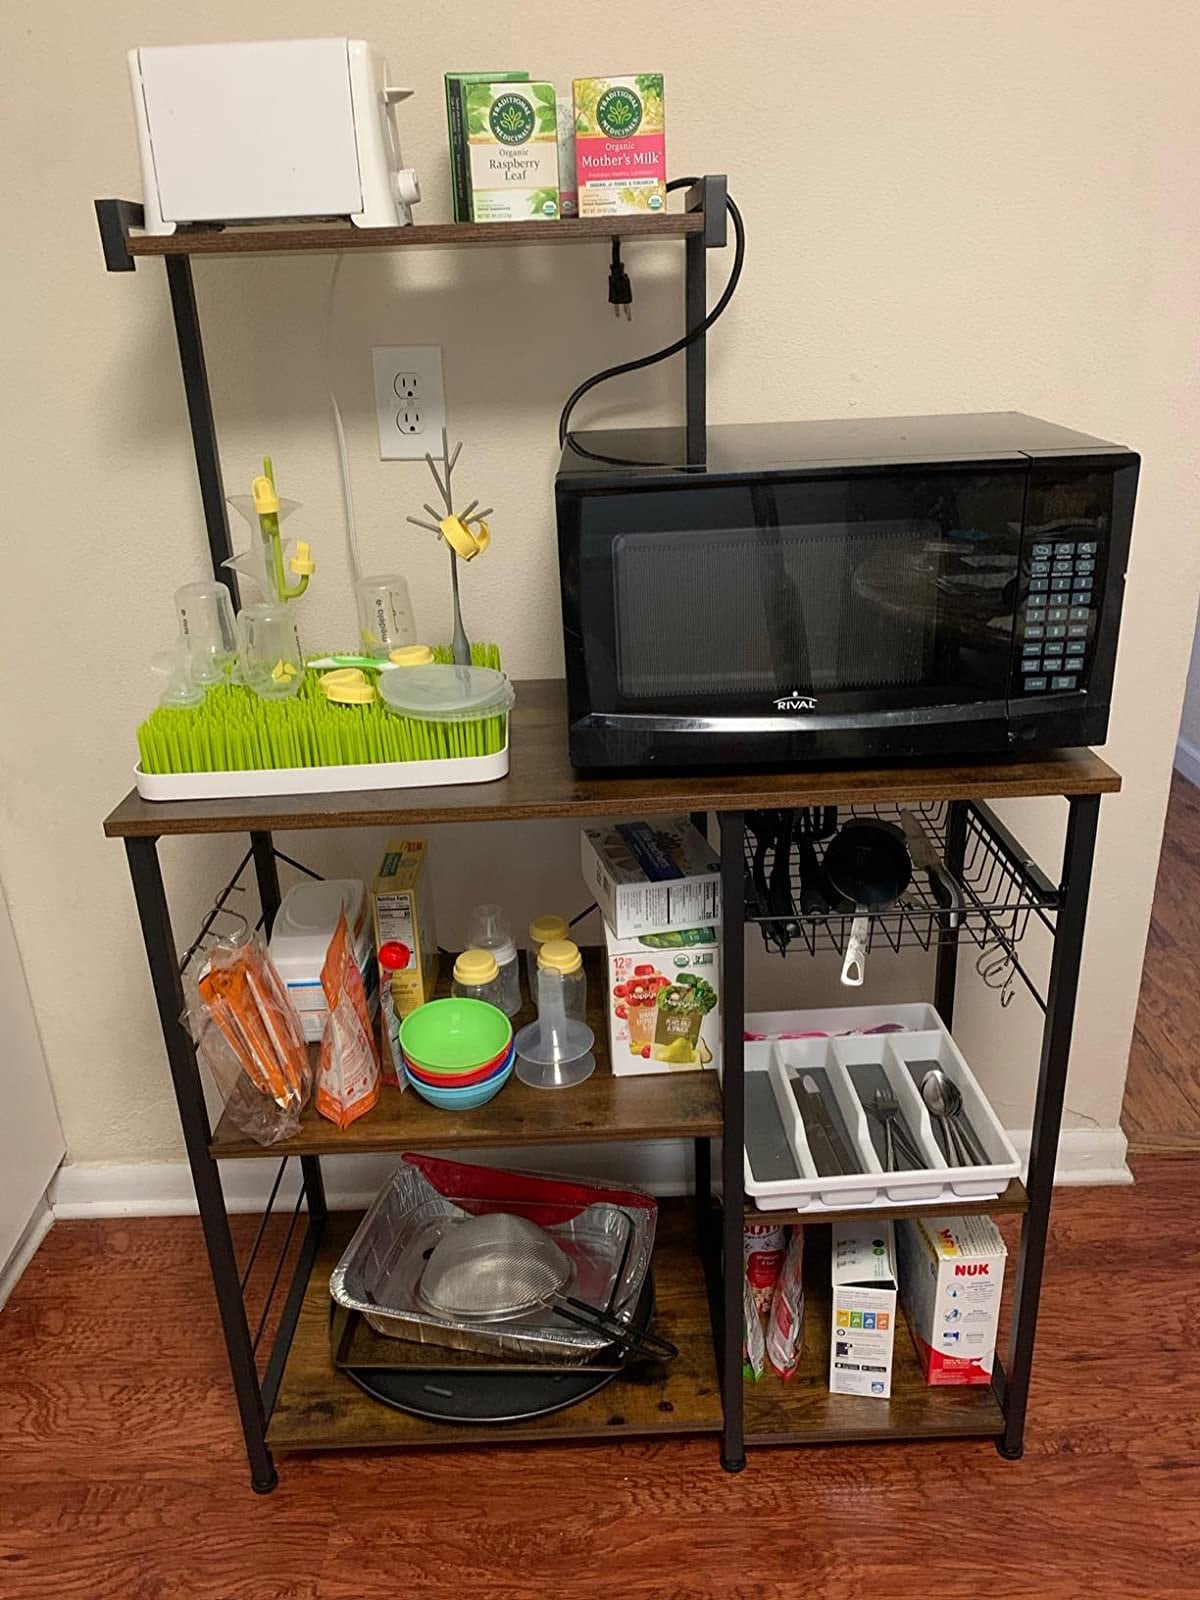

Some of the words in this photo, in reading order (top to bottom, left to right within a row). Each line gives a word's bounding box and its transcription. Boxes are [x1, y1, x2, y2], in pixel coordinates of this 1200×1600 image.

[492, 97, 530, 116] TRADITIONAL
[600, 90, 638, 111] TRADITIONAL
[494, 122, 532, 142] MEDICINALS
[601, 116, 639, 136] MEDICINALS
[499, 148, 529, 158] Organic
[605, 142, 636, 152] Organic
[489, 158, 540, 172] Raspberry
[582, 153, 631, 168] Mother's
[633, 151, 660, 165] Milk
[504, 170, 526, 180] Leaf
[777, 701, 815, 710] RIVAL
[613, 957, 625, 969] 12
[954, 1263, 989, 1276] NUK
